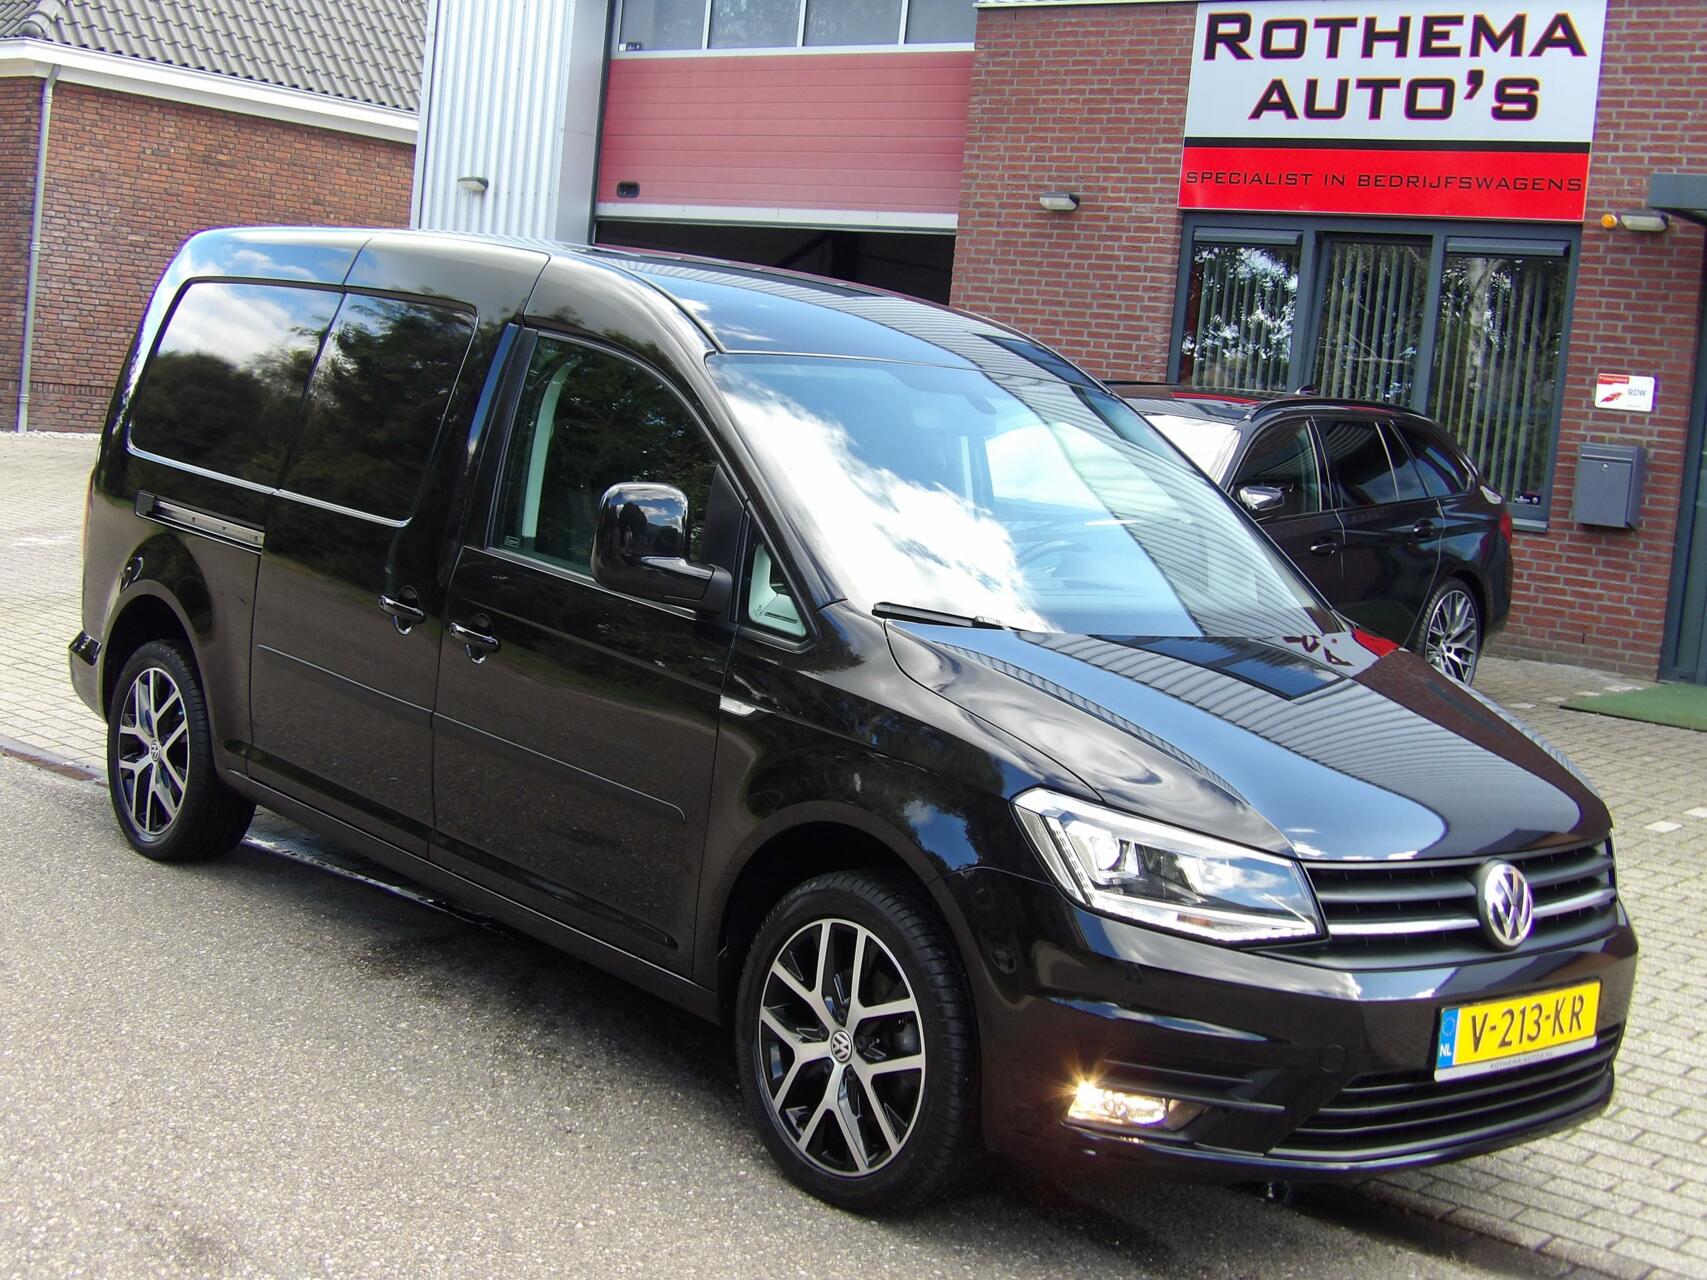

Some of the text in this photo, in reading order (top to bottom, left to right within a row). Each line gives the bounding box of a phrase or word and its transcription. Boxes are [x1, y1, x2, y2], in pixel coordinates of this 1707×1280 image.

[1203, 12, 1588, 61] ROTHEMA
[1248, 69, 1540, 121] AUTO'S
[1185, 171, 1582, 192] SPECIALIST IN BEDRIJFSWAGENS
[1627, 387, 1647, 397] RDW
[1471, 994, 1584, 1053] V-213-KR
[1439, 1043, 1452, 1057] NL
